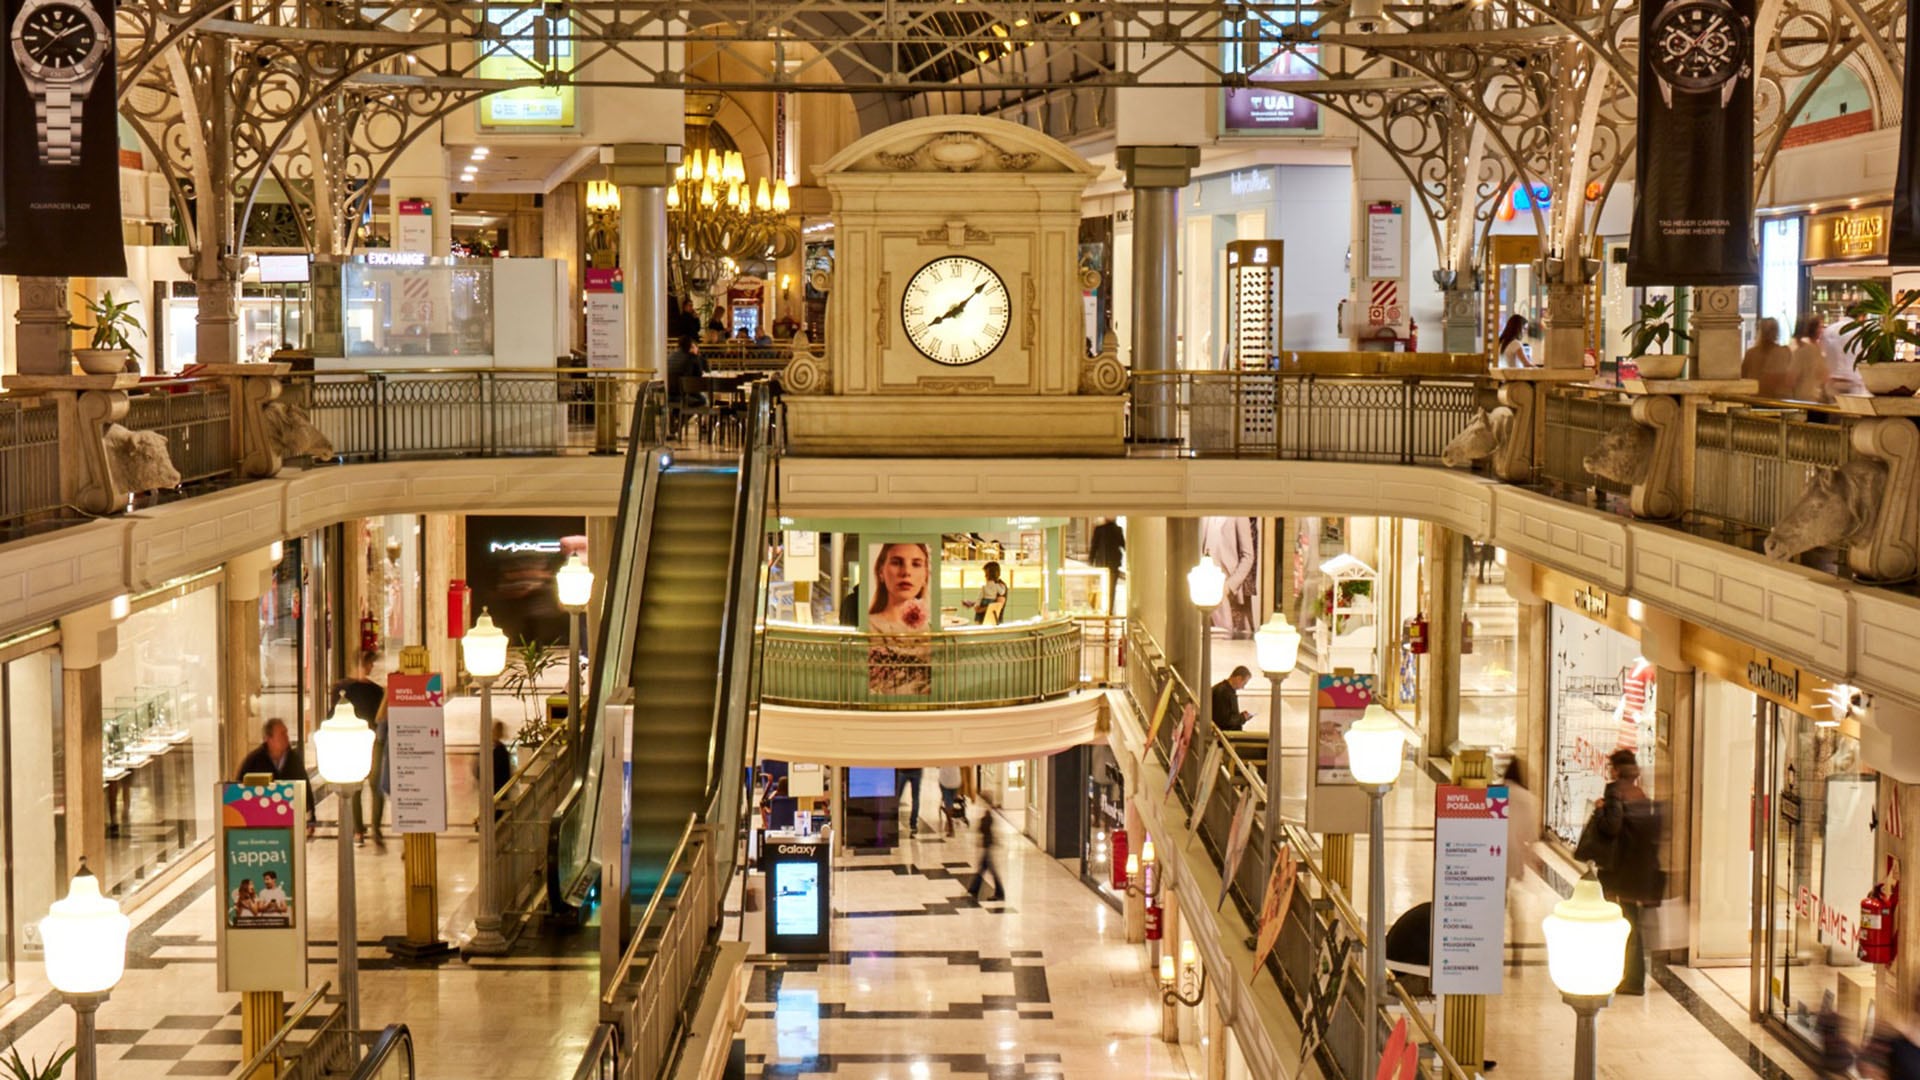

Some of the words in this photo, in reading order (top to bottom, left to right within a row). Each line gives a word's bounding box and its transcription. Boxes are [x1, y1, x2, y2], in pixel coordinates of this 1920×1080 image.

[1264, 96, 1294, 110] UAI
[1659, 219, 1672, 227] TAG
[1673, 219, 1696, 227] HEUER
[1697, 219, 1730, 227] CARRERA
[1663, 228, 1691, 236] CALIBRE
[1693, 228, 1717, 236] HEUER
[368, 252, 425, 265] EXCHANGE
[1747, 657, 1799, 705] cacharel
[1446, 802, 1486, 810] POSADAS
[778, 844, 816, 856] Galaxy
